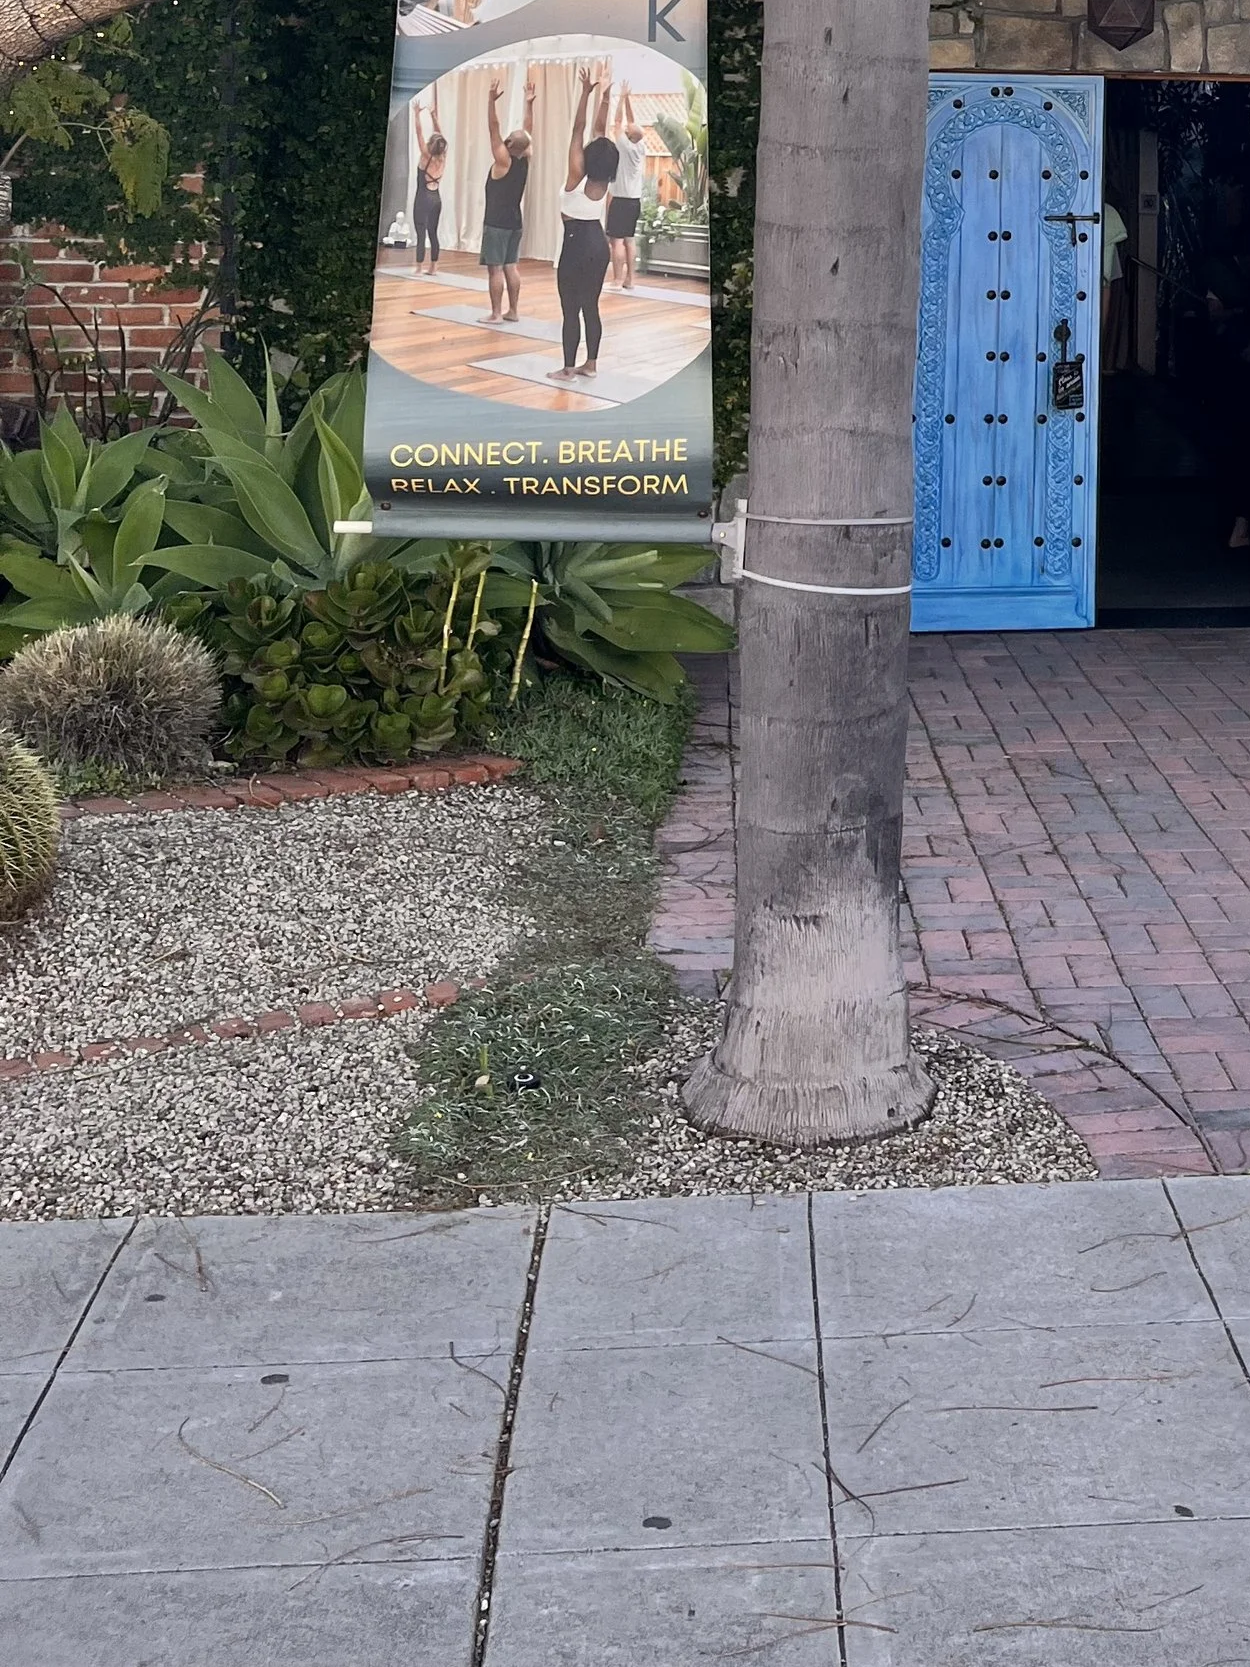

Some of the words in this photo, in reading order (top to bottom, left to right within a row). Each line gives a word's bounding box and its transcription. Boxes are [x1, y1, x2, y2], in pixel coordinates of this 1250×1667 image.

[390, 440, 549, 467] CONNECT.
[558, 438, 689, 464] BREATHE
[390, 477, 482, 494] RELAX
[503, 474, 689, 496] TRANSFORM
